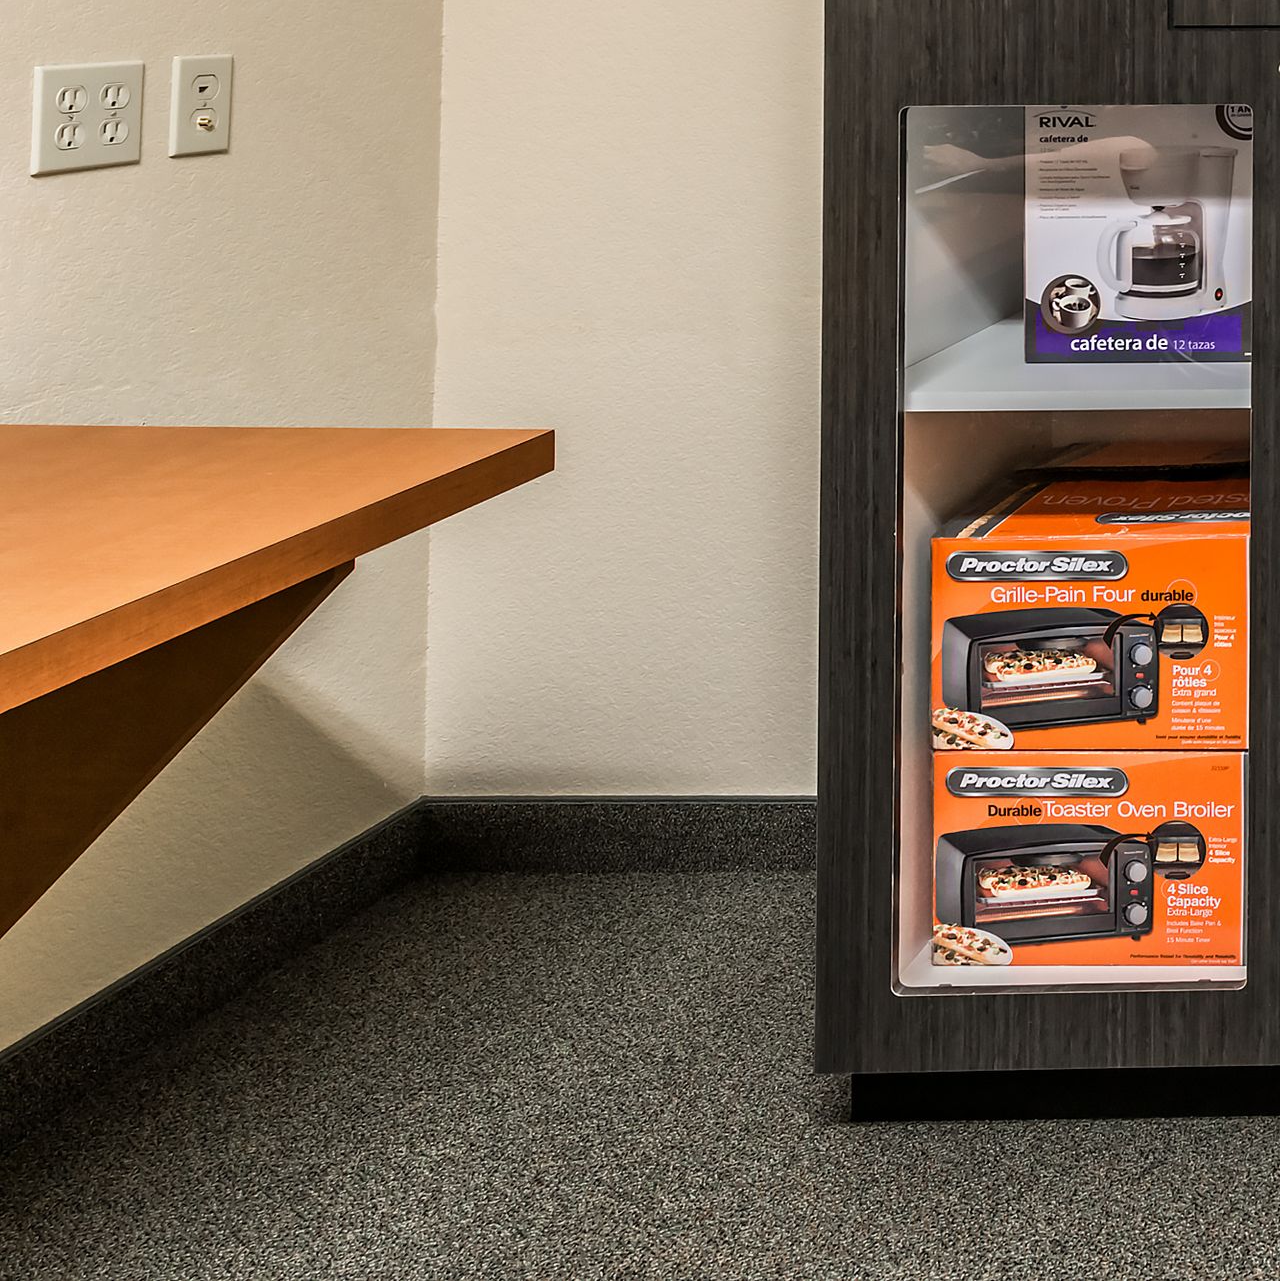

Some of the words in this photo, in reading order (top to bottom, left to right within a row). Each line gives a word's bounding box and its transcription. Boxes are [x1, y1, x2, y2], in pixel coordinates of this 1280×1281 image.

[1039, 116, 1096, 128] RIVAL
[1039, 134, 1075, 143] cafetera
[1076, 134, 1088, 143] de
[1070, 334, 1142, 351] cafetera
[1145, 334, 1168, 351] de
[1173, 340, 1186, 350] 12
[1188, 340, 1216, 350] tazas
[959, 557, 1050, 573] Proctor
[1050, 556, 1113, 573] Silex
[990, 585, 1086, 604] Grille-Pain
[1092, 585, 1136, 603] Four
[1140, 589, 1194, 603] durable
[1172, 665, 1200, 676] Pour
[1203, 665, 1212, 675] 4
[1172, 676, 1207, 687] rôties
[1172, 688, 1192, 697] Extra
[1194, 688, 1217, 698] grand
[959, 774, 1050, 789] Proctor
[1050, 773, 1113, 789] Silex
[987, 804, 1042, 817] Durable
[1042, 801, 1112, 817] Toaster
[1117, 801, 1166, 817] Oven
[1173, 801, 1236, 818] Broiler
[1167, 884, 1176, 895] 4
[1177, 883, 1209, 895] Slice
[1167, 896, 1221, 909] Capacity
[1167, 908, 1213, 918] Extra-Large
